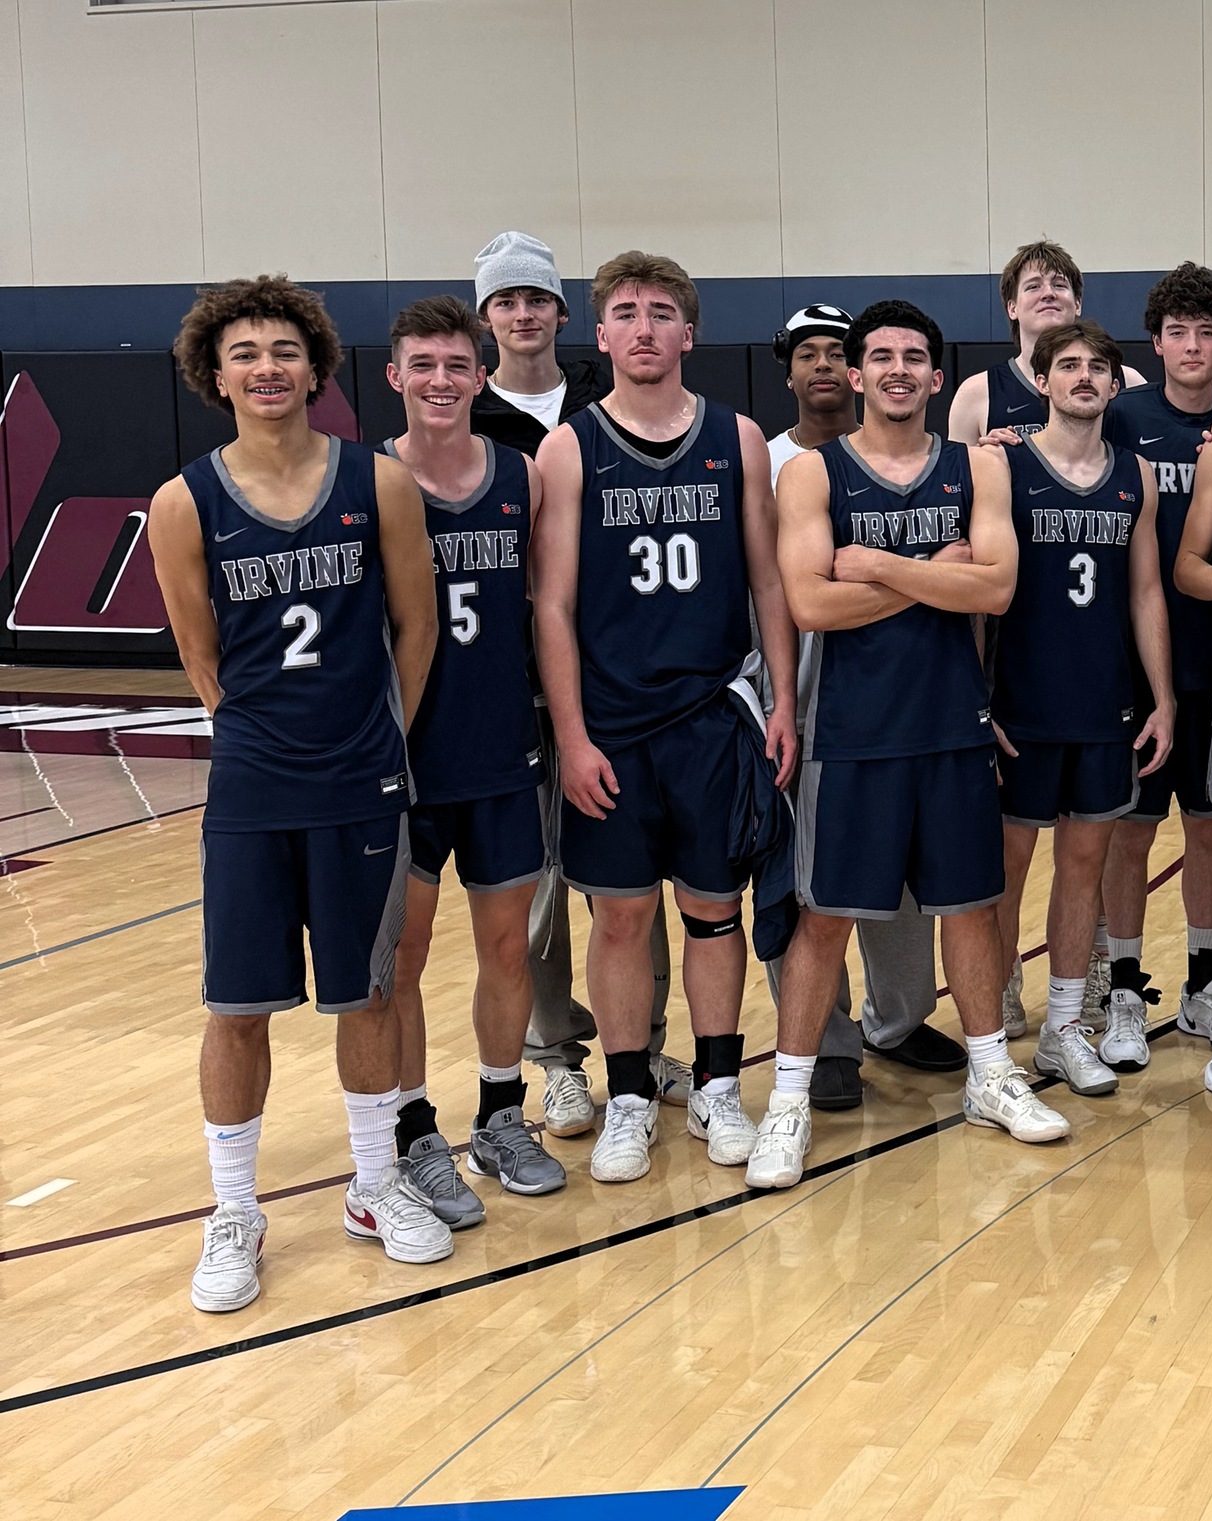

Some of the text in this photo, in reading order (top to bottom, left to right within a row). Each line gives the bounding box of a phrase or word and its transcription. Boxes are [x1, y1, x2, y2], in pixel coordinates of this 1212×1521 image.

[601, 483, 721, 527] IRVINE
[850, 505, 960, 548] IRVINE
[1031, 508, 1132, 546] IRVINE
[221, 541, 363, 601] IRVINE
[429, 529, 520, 574] VINE
[628, 532, 702, 596] 30
[1068, 553, 1097, 607] 3
[281, 603, 321, 670] 2
[448, 581, 480, 646] 5
